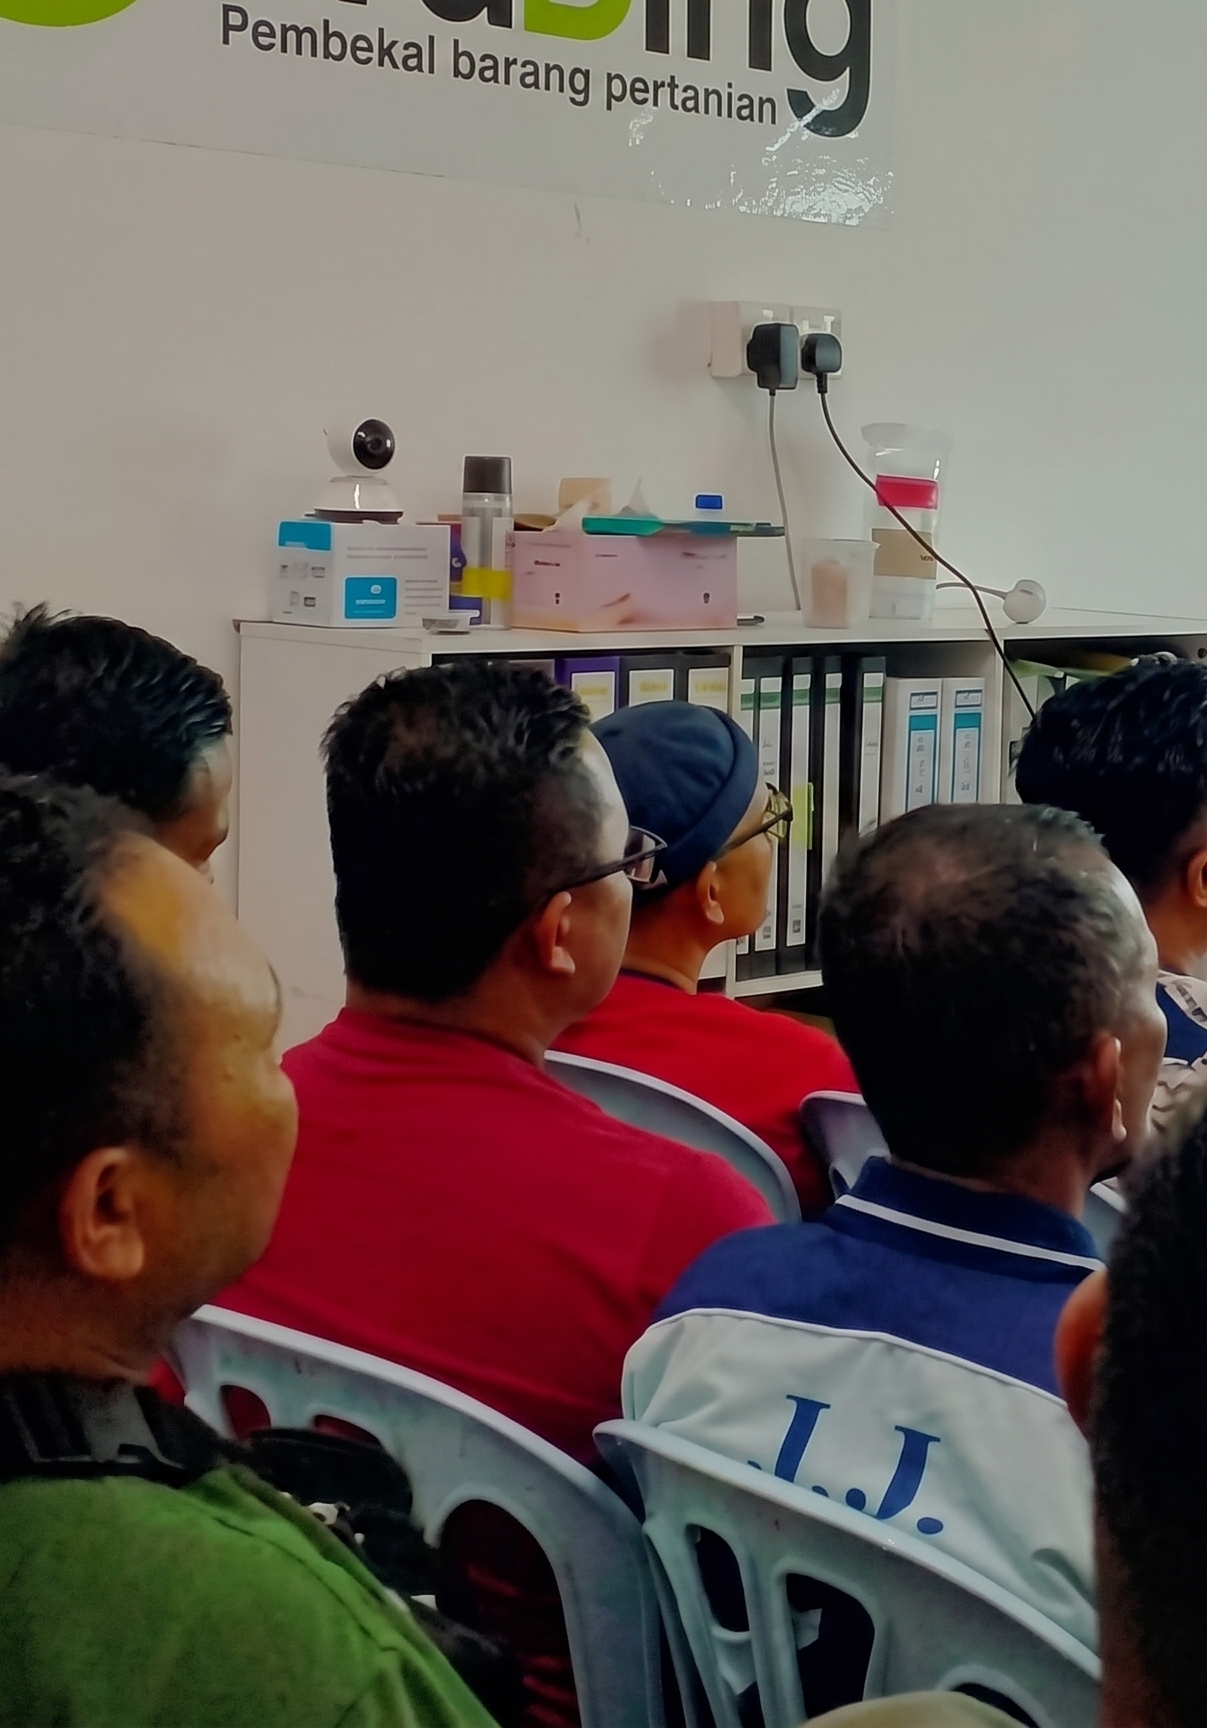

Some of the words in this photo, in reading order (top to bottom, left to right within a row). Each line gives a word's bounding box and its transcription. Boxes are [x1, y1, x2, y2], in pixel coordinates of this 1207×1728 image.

[221, 3, 436, 75] Pembekal
[453, 39, 591, 107] barang
[605, 71, 778, 125] pertanian
